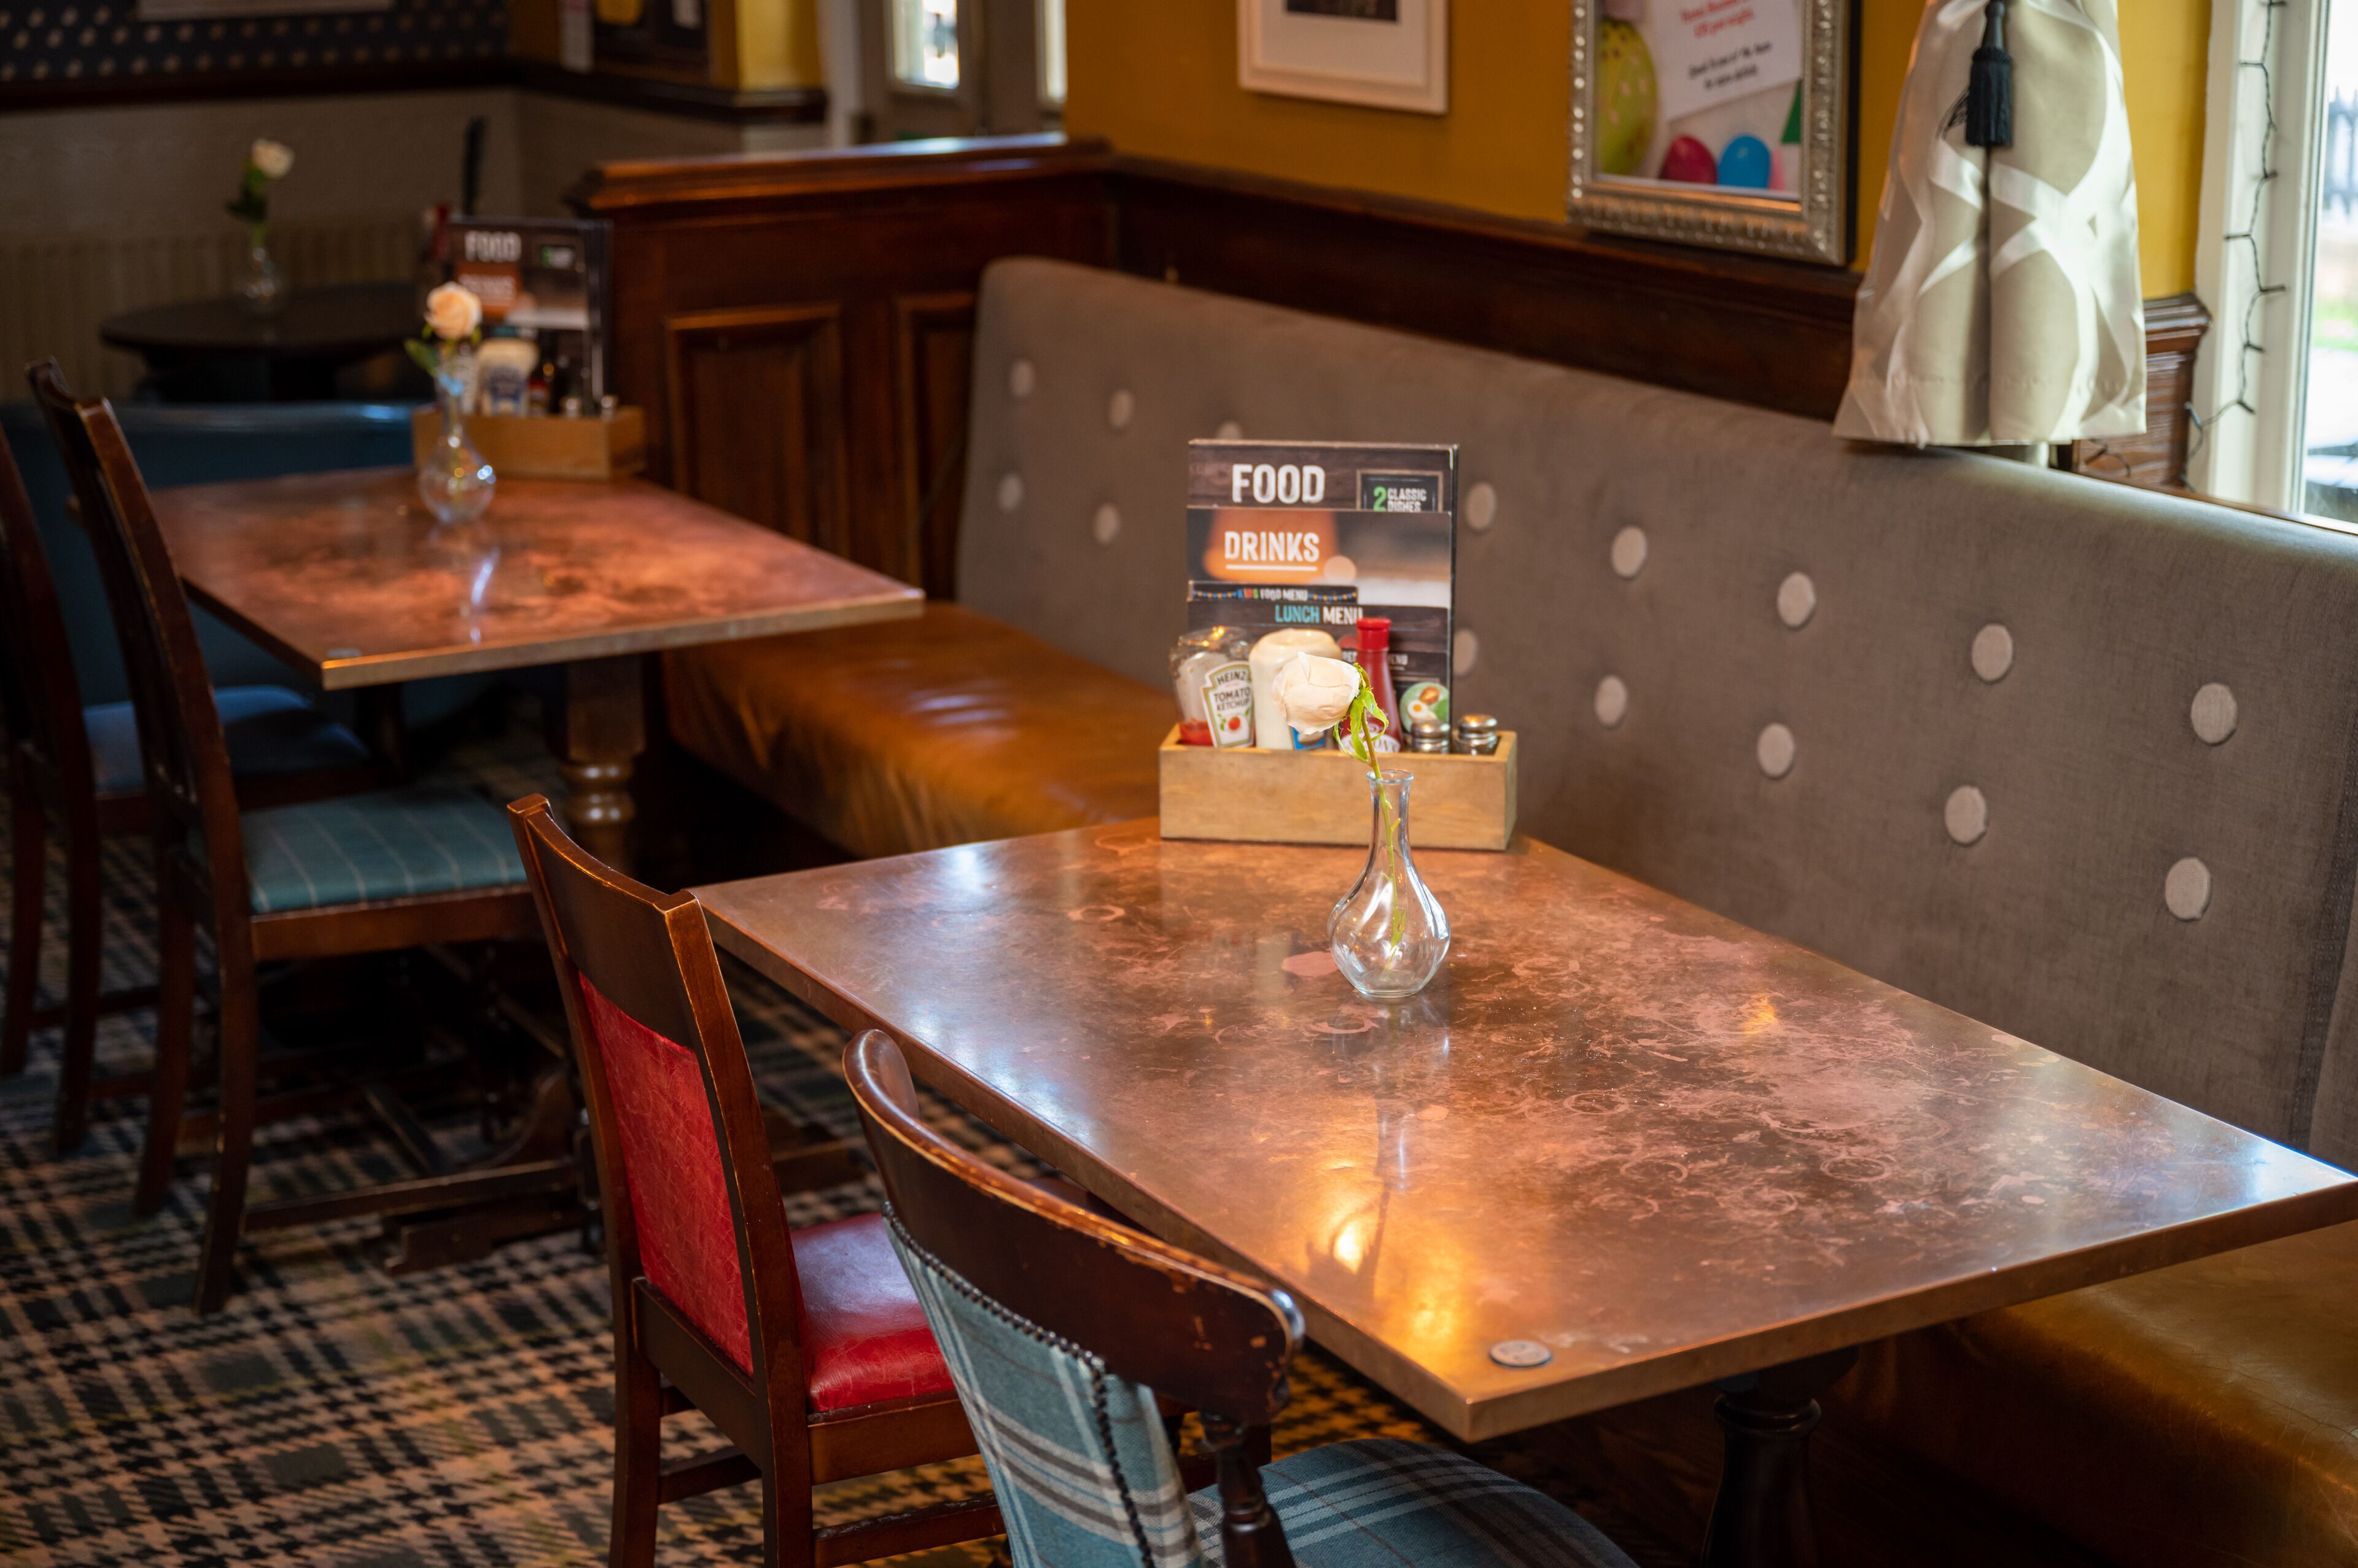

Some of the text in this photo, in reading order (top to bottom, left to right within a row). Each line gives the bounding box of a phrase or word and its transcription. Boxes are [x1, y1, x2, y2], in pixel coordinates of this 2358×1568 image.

[465, 231, 521, 262] FOOD
[1232, 464, 1325, 503] FOOD
[1373, 486, 1427, 511] 2 CLASSIC
[1387, 500, 1422, 511] DISHES
[1224, 531, 1320, 562] DRINKS
[1283, 589, 1309, 601] MENU
[1275, 605, 1363, 624] LUNCH MENU
[1216, 670, 1246, 685] HEINZ
[1214, 686, 1250, 702] TOMATO
[1217, 698, 1249, 711] KETCHUP
